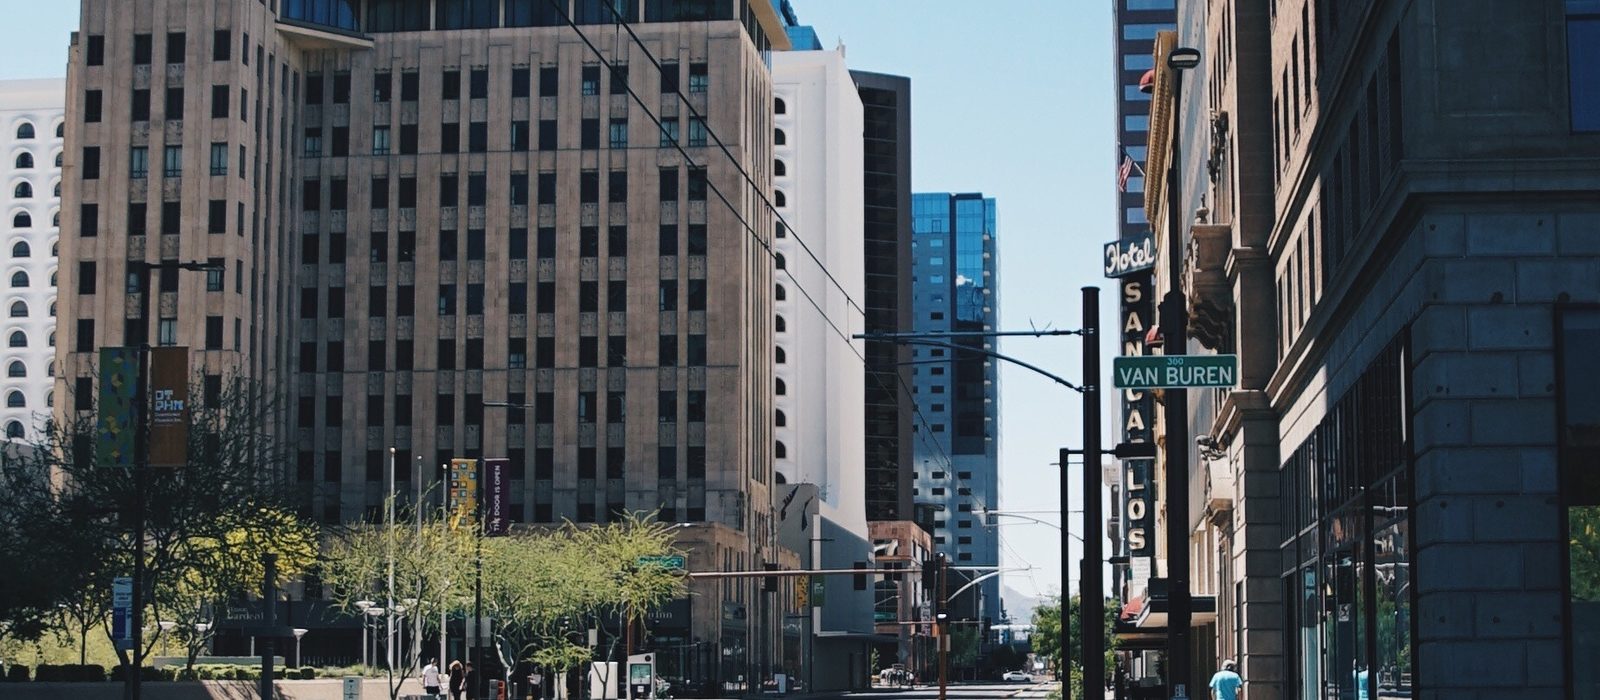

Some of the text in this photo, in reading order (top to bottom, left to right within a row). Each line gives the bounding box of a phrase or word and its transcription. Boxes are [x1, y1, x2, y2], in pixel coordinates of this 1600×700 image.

[1106, 237, 1154, 273] Hotel
[1125, 282, 1143, 356] SAN
[1120, 366, 1232, 385] VAN BUREN
[1126, 388, 1146, 550] CALOS
